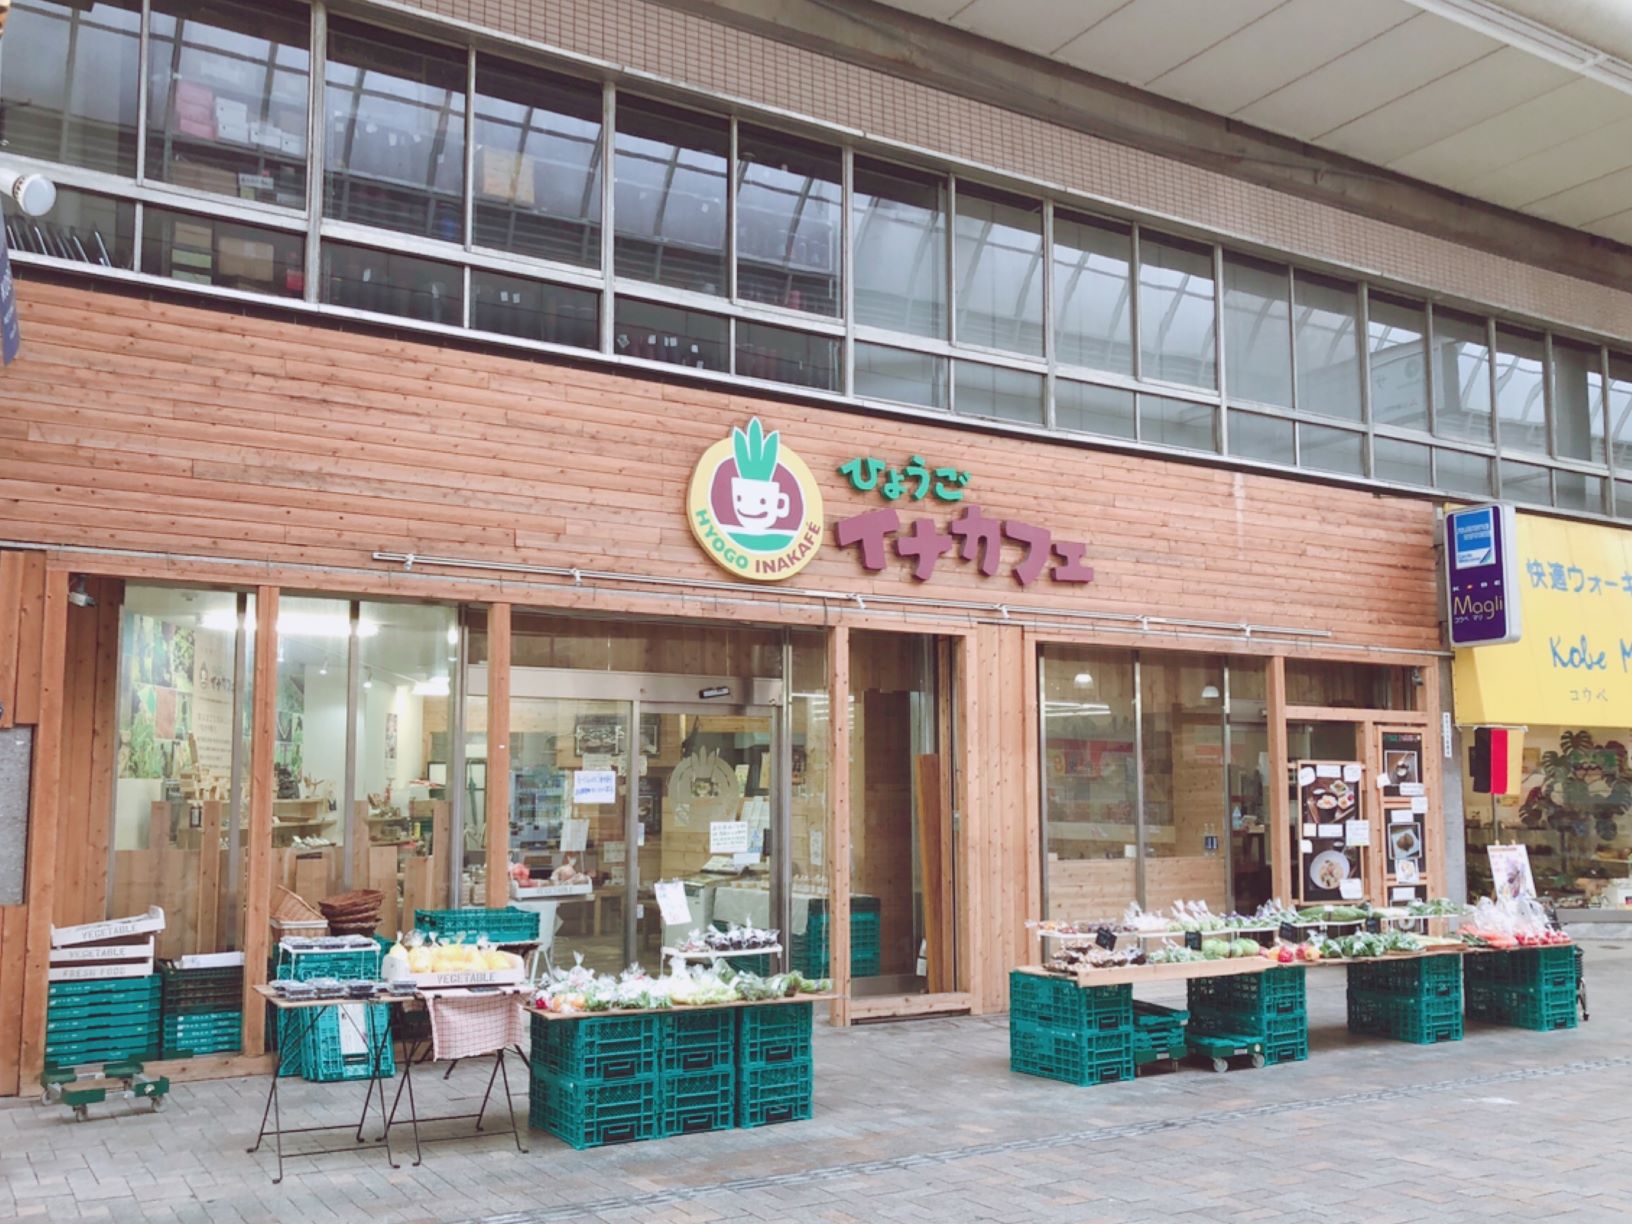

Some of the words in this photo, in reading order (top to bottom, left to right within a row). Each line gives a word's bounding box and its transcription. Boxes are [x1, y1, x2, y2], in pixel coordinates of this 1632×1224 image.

[839, 455, 971, 502] ひょうご
[696, 509, 748, 570] HYOGO
[836, 505, 1095, 587] イナカフェ
[1454, 594, 1503, 620] Magli
[1549, 634, 1607, 671] Kobe
[1569, 688, 1608, 703] コウベ
[81, 925, 137, 939] VEGETABLE
[69, 948, 126, 958] VEGETABLE
[100, 967, 126, 975] FOOD
[437, 972, 495, 984] VEGETABLE
